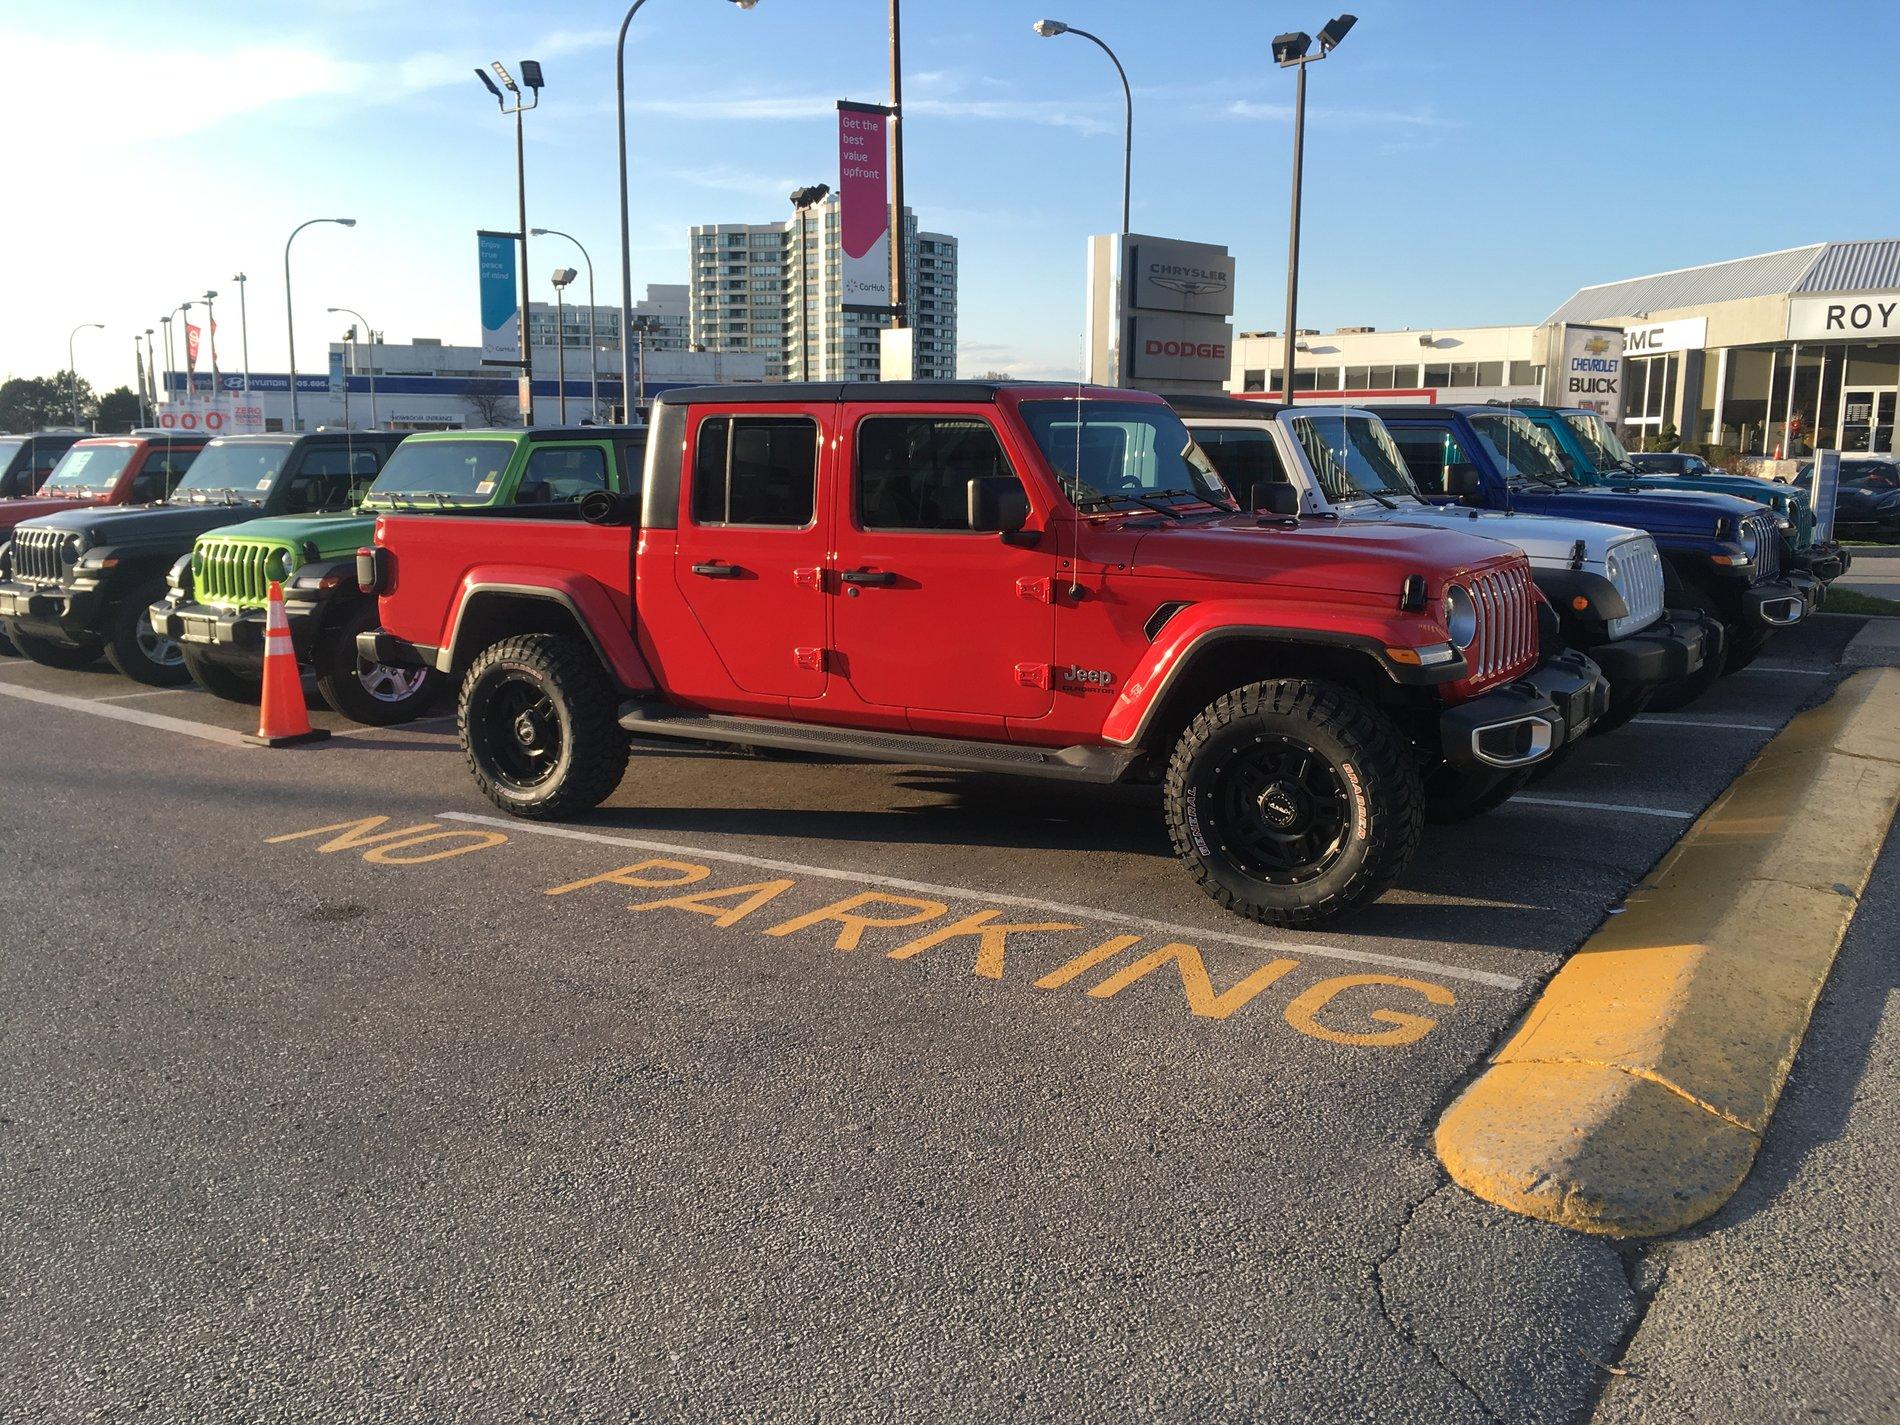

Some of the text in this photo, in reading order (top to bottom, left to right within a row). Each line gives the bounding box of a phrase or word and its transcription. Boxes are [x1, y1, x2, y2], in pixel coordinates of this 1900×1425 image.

[843, 117, 879, 131] Get the
[843, 133, 865, 145] best
[843, 151, 868, 161] value
[843, 167, 880, 179] upfront
[481, 241, 501, 250] Enjoy
[481, 251, 498, 259] true
[481, 262, 503, 270] peace
[1150, 263, 1227, 281] CHRYSLER
[859, 283, 886, 292] CarHub
[1826, 303, 1898, 330] ROY
[1145, 340, 1225, 359] DODGE
[1571, 357, 1619, 373] CHEVROLET
[1569, 377, 1617, 393] BUICK
[1064, 664, 1112, 687] Jeep
[1186, 786, 1211, 857] GENERAL
[264, 815, 509, 865] NO
[545, 858, 1457, 1048] PARKING
